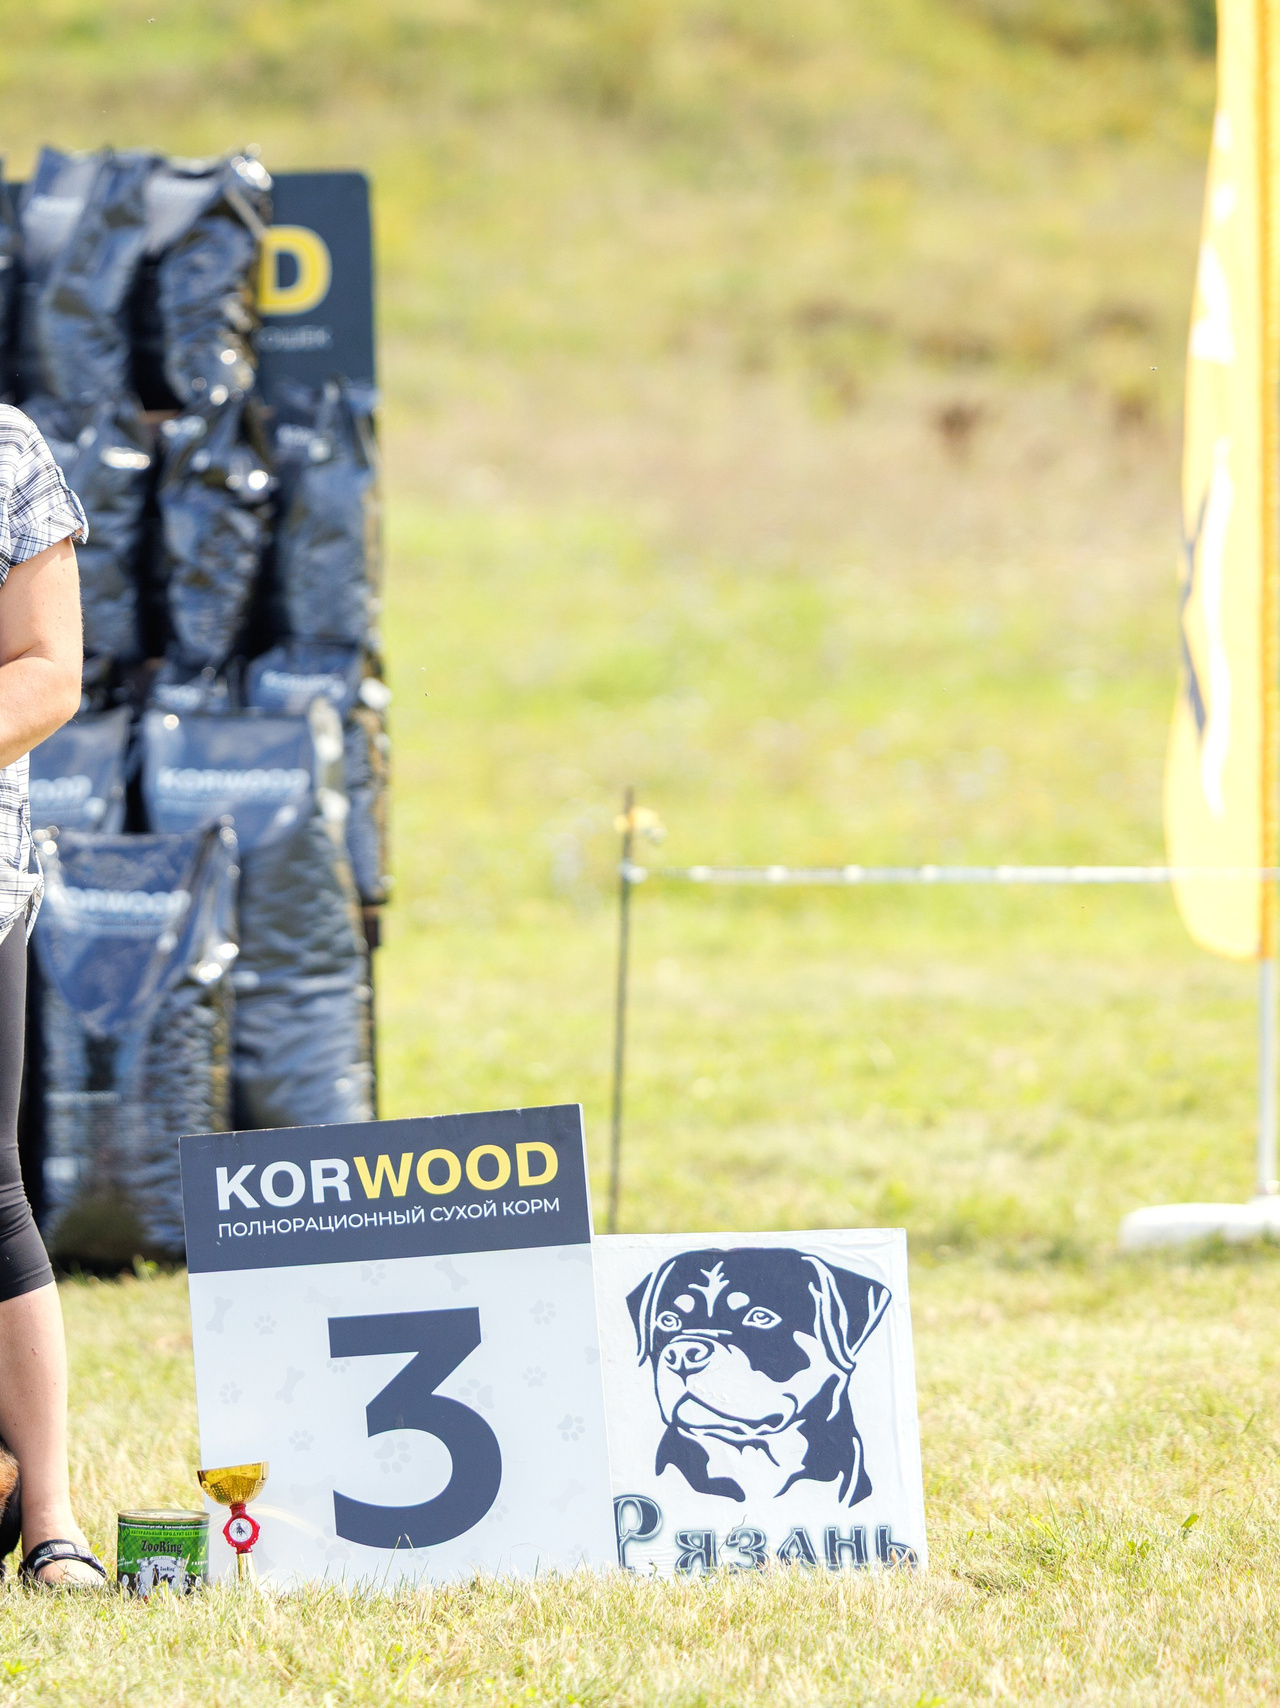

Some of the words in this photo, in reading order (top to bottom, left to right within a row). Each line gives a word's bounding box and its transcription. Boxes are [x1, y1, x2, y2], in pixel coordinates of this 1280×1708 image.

[215, 1140, 559, 1211] KORWOOD
[218, 1205, 425, 1238] ПОЛНОРАЦИОННЫЙ
[430, 1199, 497, 1222] СУХОЙ
[503, 1197, 560, 1217] КОРМ
[327, 1306, 503, 1550] 3
[141, 1540, 182, 1555] ZooRing
